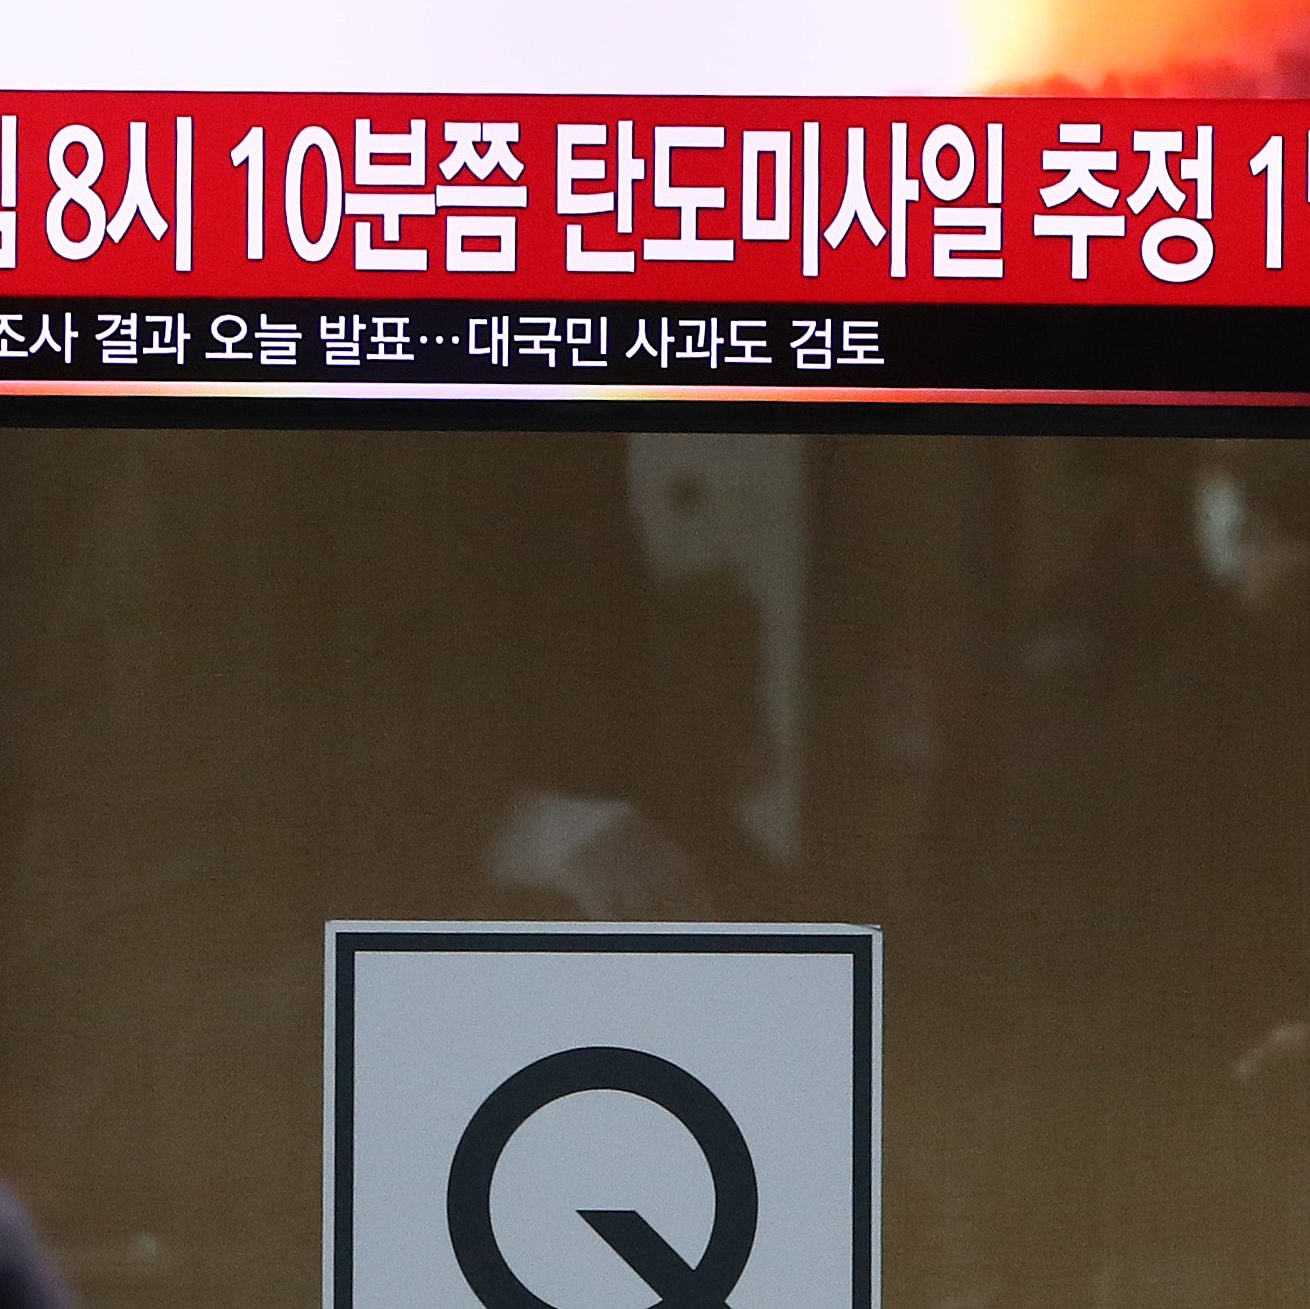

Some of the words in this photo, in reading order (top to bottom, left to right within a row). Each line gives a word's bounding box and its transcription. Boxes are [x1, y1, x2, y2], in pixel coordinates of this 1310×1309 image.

[45, 115, 193, 272] 8시
[230, 118, 529, 273] 10분쯤
[556, 120, 1005, 279] 탄도미사일
[1032, 123, 1216, 283] 추정
[94, 312, 192, 365] 결과
[204, 313, 304, 366] 오늘
[624, 316, 774, 369] 사과도
[788, 318, 885, 370] 검토
